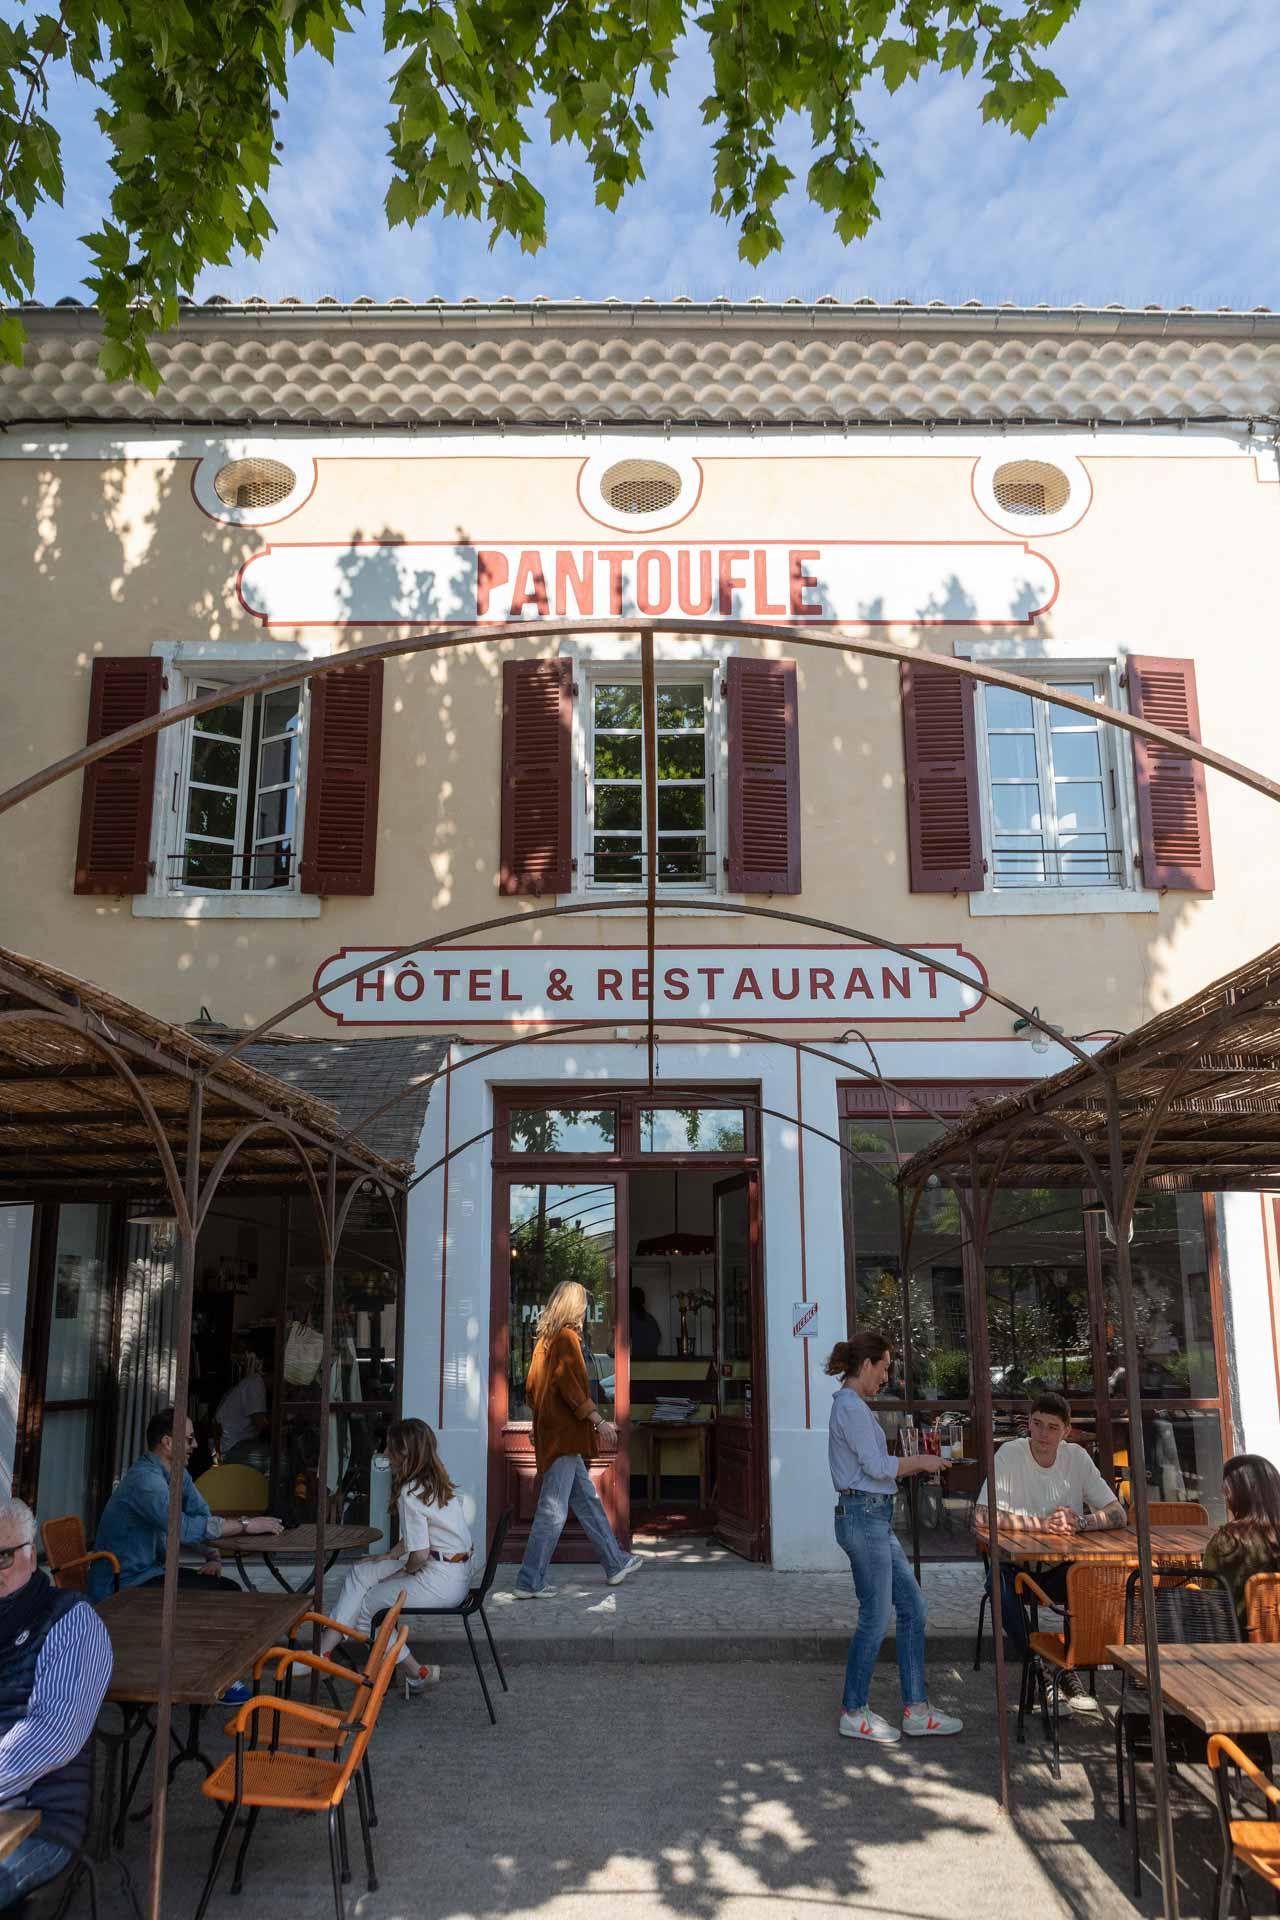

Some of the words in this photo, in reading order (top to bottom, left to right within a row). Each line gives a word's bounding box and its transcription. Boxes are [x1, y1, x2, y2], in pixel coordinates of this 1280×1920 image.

[477, 550, 822, 616] PANTOUFLE
[355, 960, 523, 1001] HÔTEL
[546, 969, 573, 1001] &
[597, 966, 940, 1000] RESTAURANT
